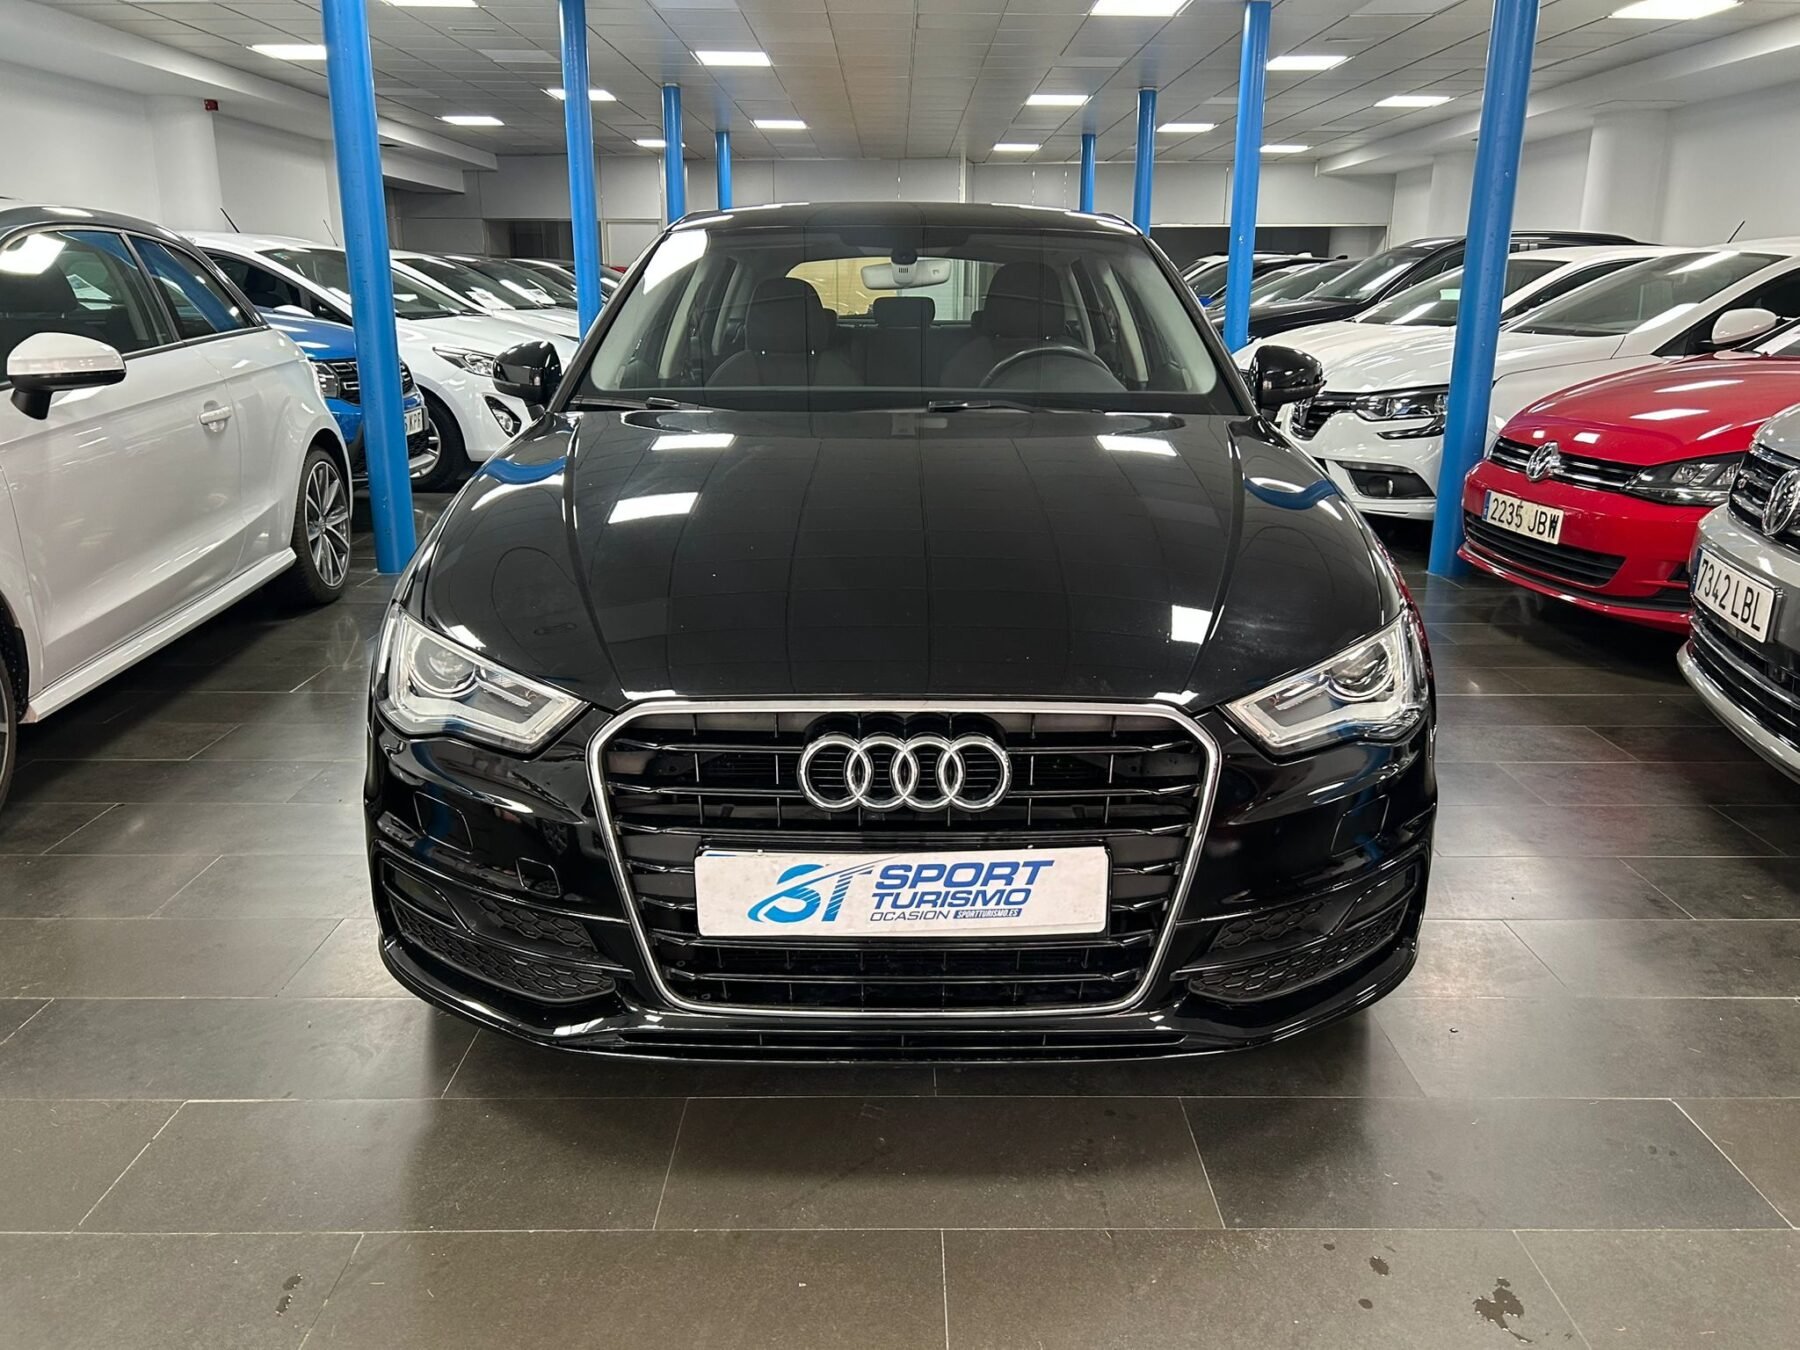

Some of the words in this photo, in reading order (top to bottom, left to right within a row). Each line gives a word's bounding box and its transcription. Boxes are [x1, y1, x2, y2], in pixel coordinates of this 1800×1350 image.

[1490, 498, 1524, 528] 2235
[1528, 509, 1560, 539] JBW
[1697, 558, 1731, 610] 7342
[1730, 580, 1761, 632] LBL
[875, 860, 1055, 890] SPORT
[871, 888, 1032, 909] TURISMO
[870, 910, 951, 921] OCASION
[956, 909, 1019, 918] SPORTTURISMO.ES
